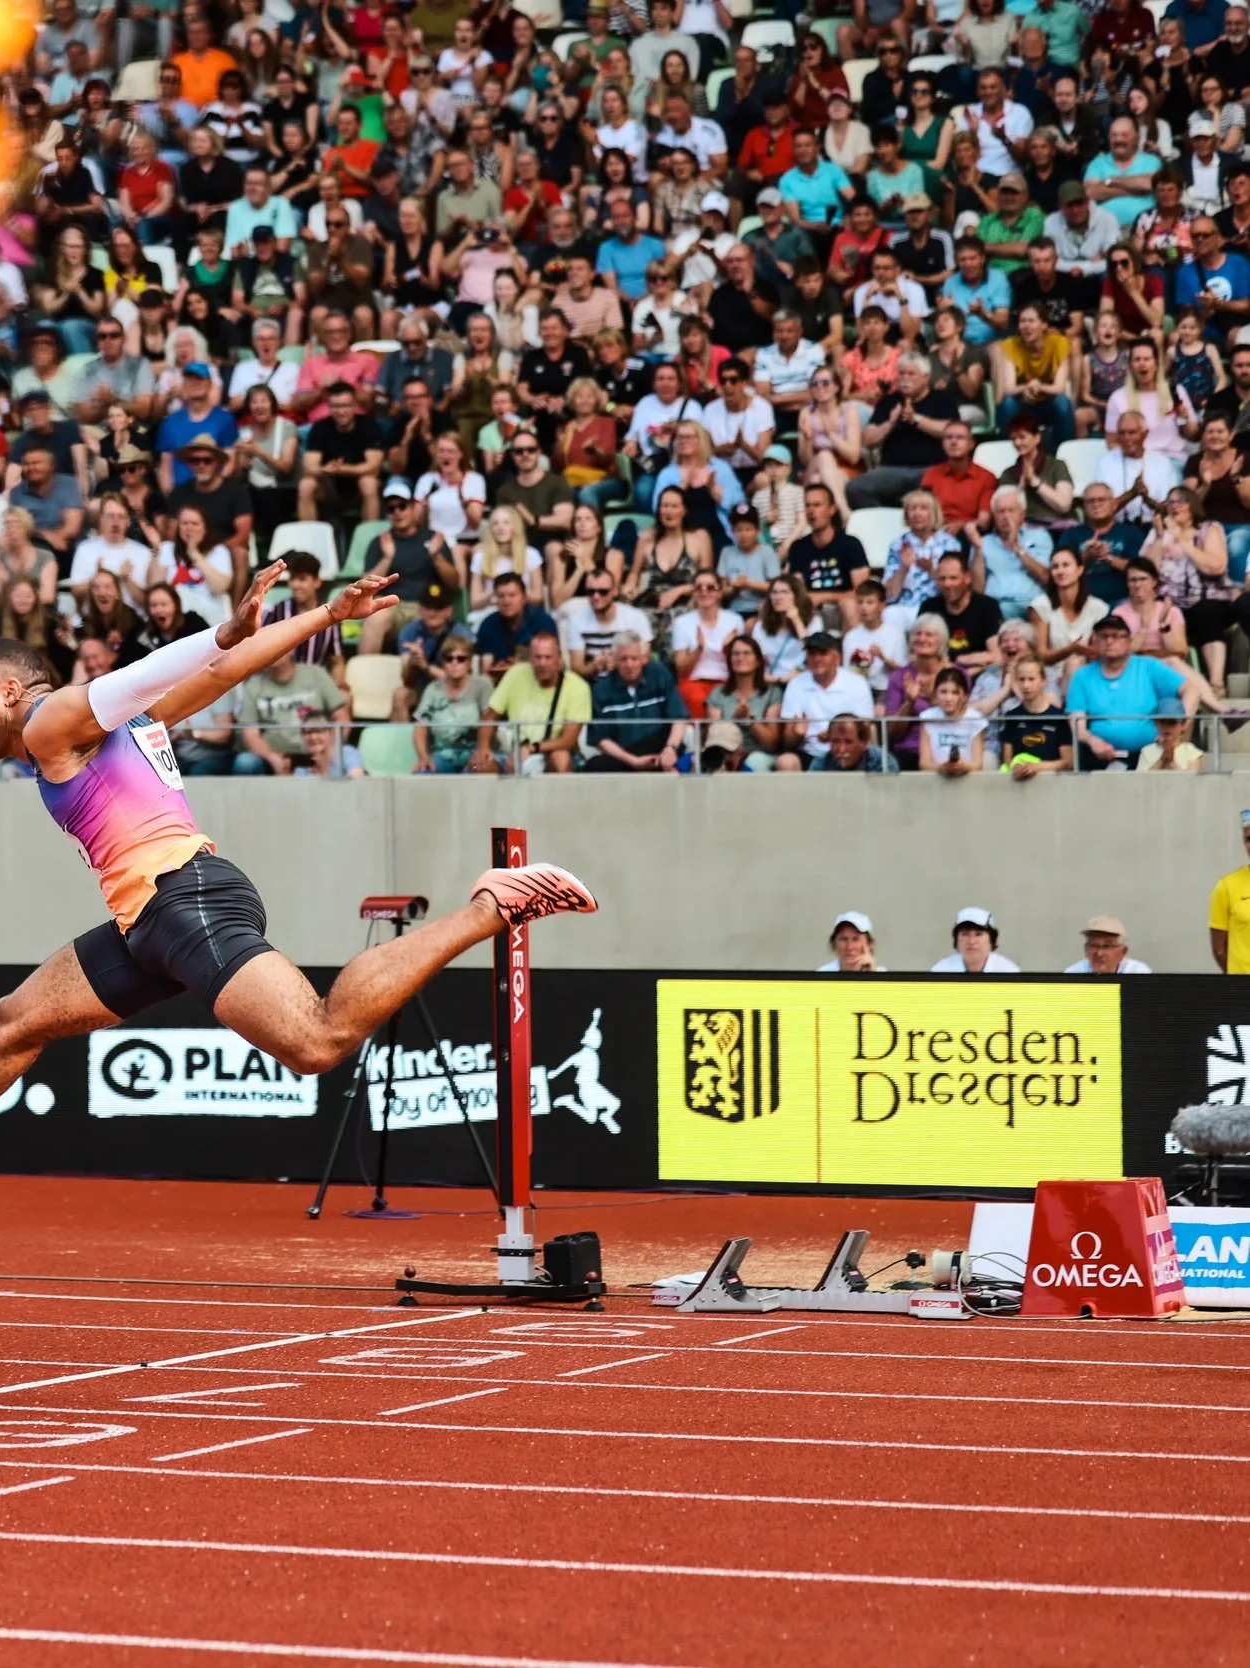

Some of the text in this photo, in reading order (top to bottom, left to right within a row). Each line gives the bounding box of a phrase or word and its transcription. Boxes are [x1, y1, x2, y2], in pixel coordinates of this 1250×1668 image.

[851, 1009, 1098, 1065] Dresden.
[185, 1091, 303, 1102] INTERNATIONAL
[1032, 1263, 1144, 1288] OMEGA
